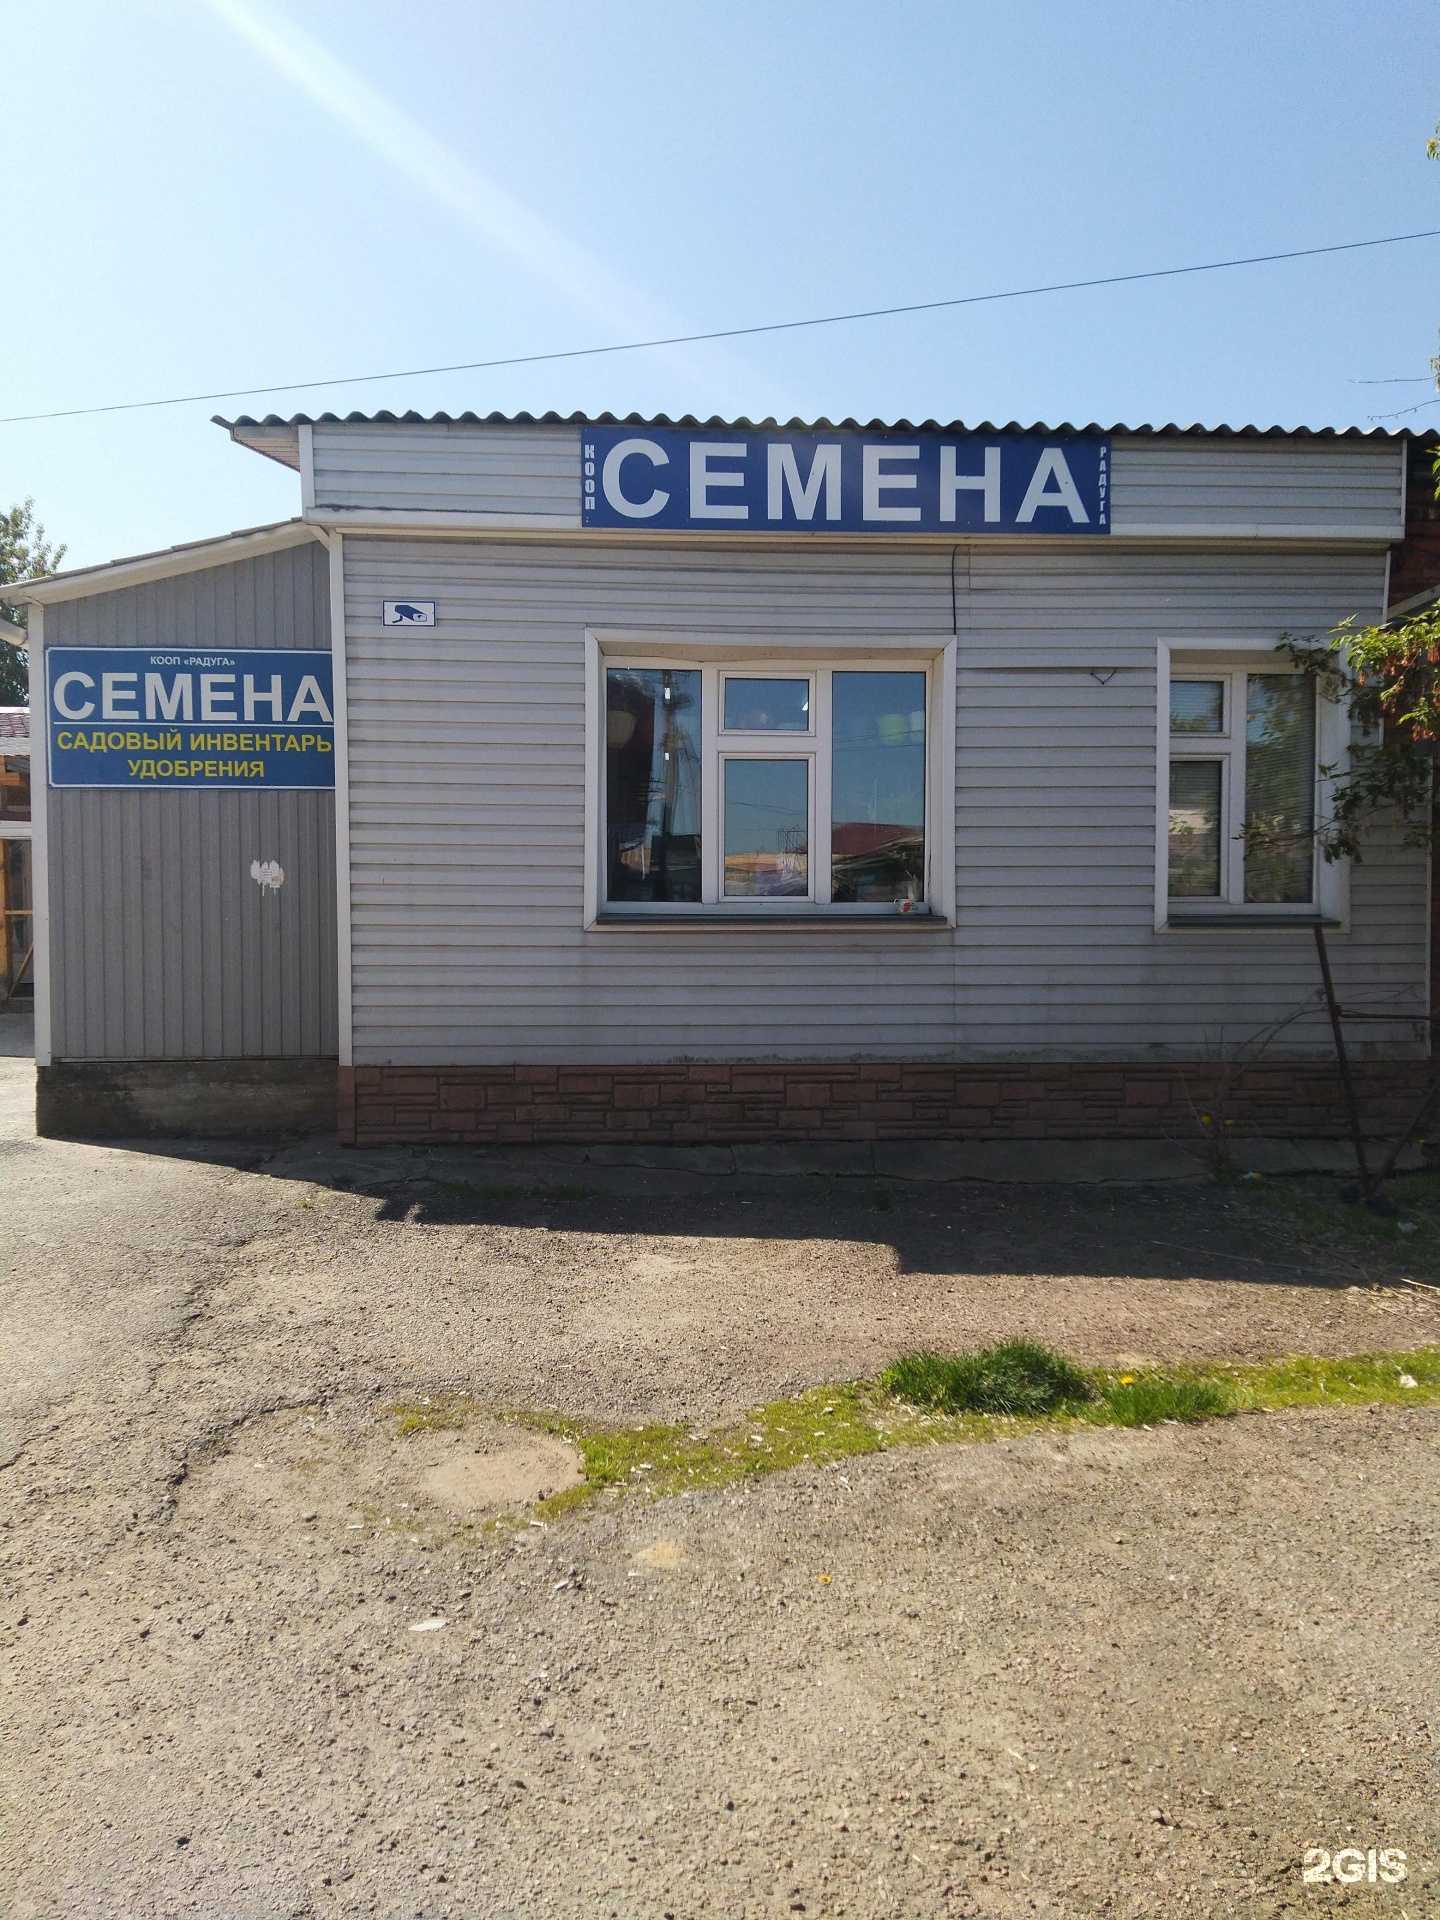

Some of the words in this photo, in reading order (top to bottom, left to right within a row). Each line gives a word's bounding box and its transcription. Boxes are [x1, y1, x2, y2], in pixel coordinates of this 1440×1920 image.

[584, 444, 595, 510] КООП
[602, 438, 1091, 523] СЕМЕНА
[150, 656, 181, 665] КООП
[184, 656, 236, 668] «РАДУГА»
[53, 671, 334, 722] СЕМЕНА
[57, 729, 182, 752] САДОВЫЙ
[190, 733, 332, 752] ИНВЕНТАРЬ
[128, 759, 264, 779] УДОБРЕНИЯ
